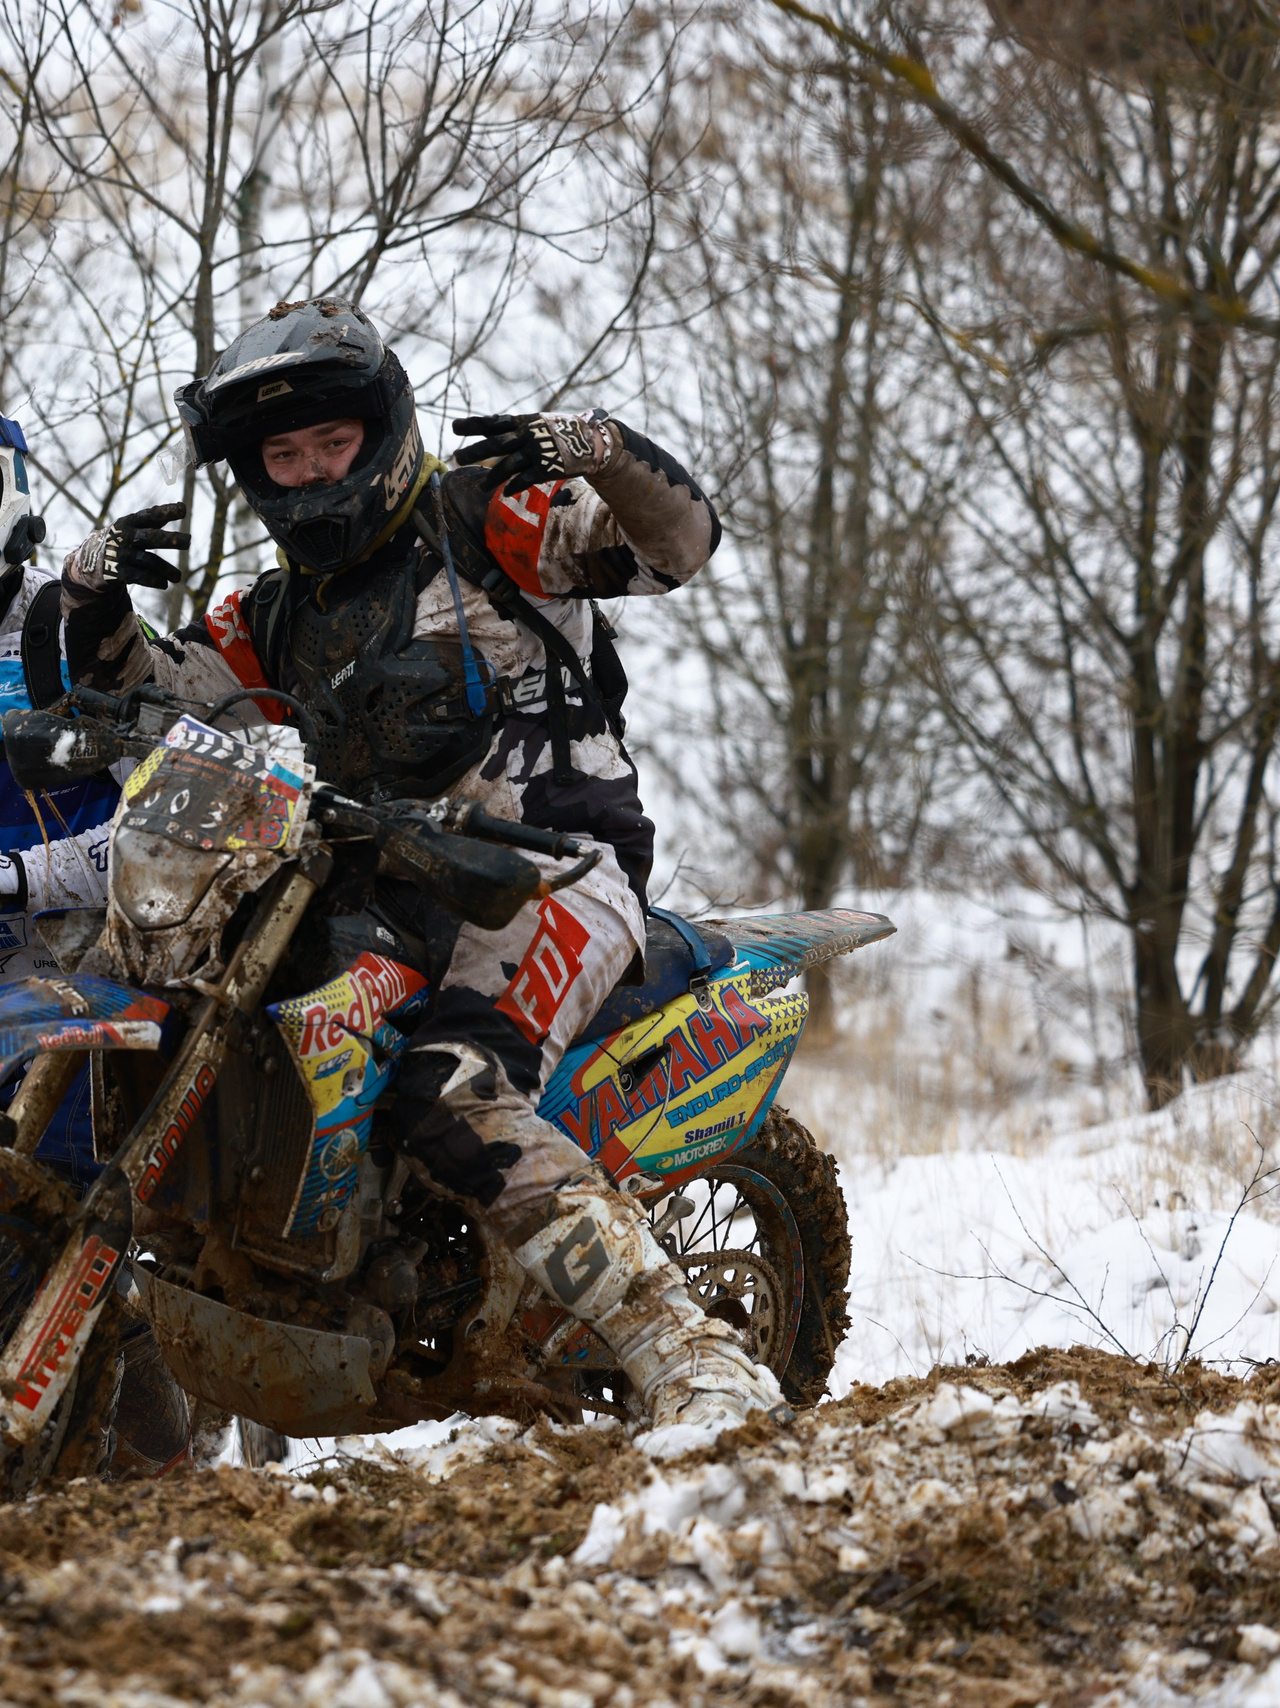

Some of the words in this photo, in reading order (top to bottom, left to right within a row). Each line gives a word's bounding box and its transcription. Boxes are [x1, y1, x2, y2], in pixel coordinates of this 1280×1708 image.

[331, 659, 356, 690] LEATT
[297, 976, 367, 1057] Red
[354, 951, 407, 1027] Bull
[558, 984, 771, 1157] YAMAHA
[664, 1034, 794, 1129] ENDURO-SPORT
[674, 1135, 729, 1168] MOTOREX
[684, 1115, 735, 1145] Shamil
[736, 1110, 747, 1129] T.
